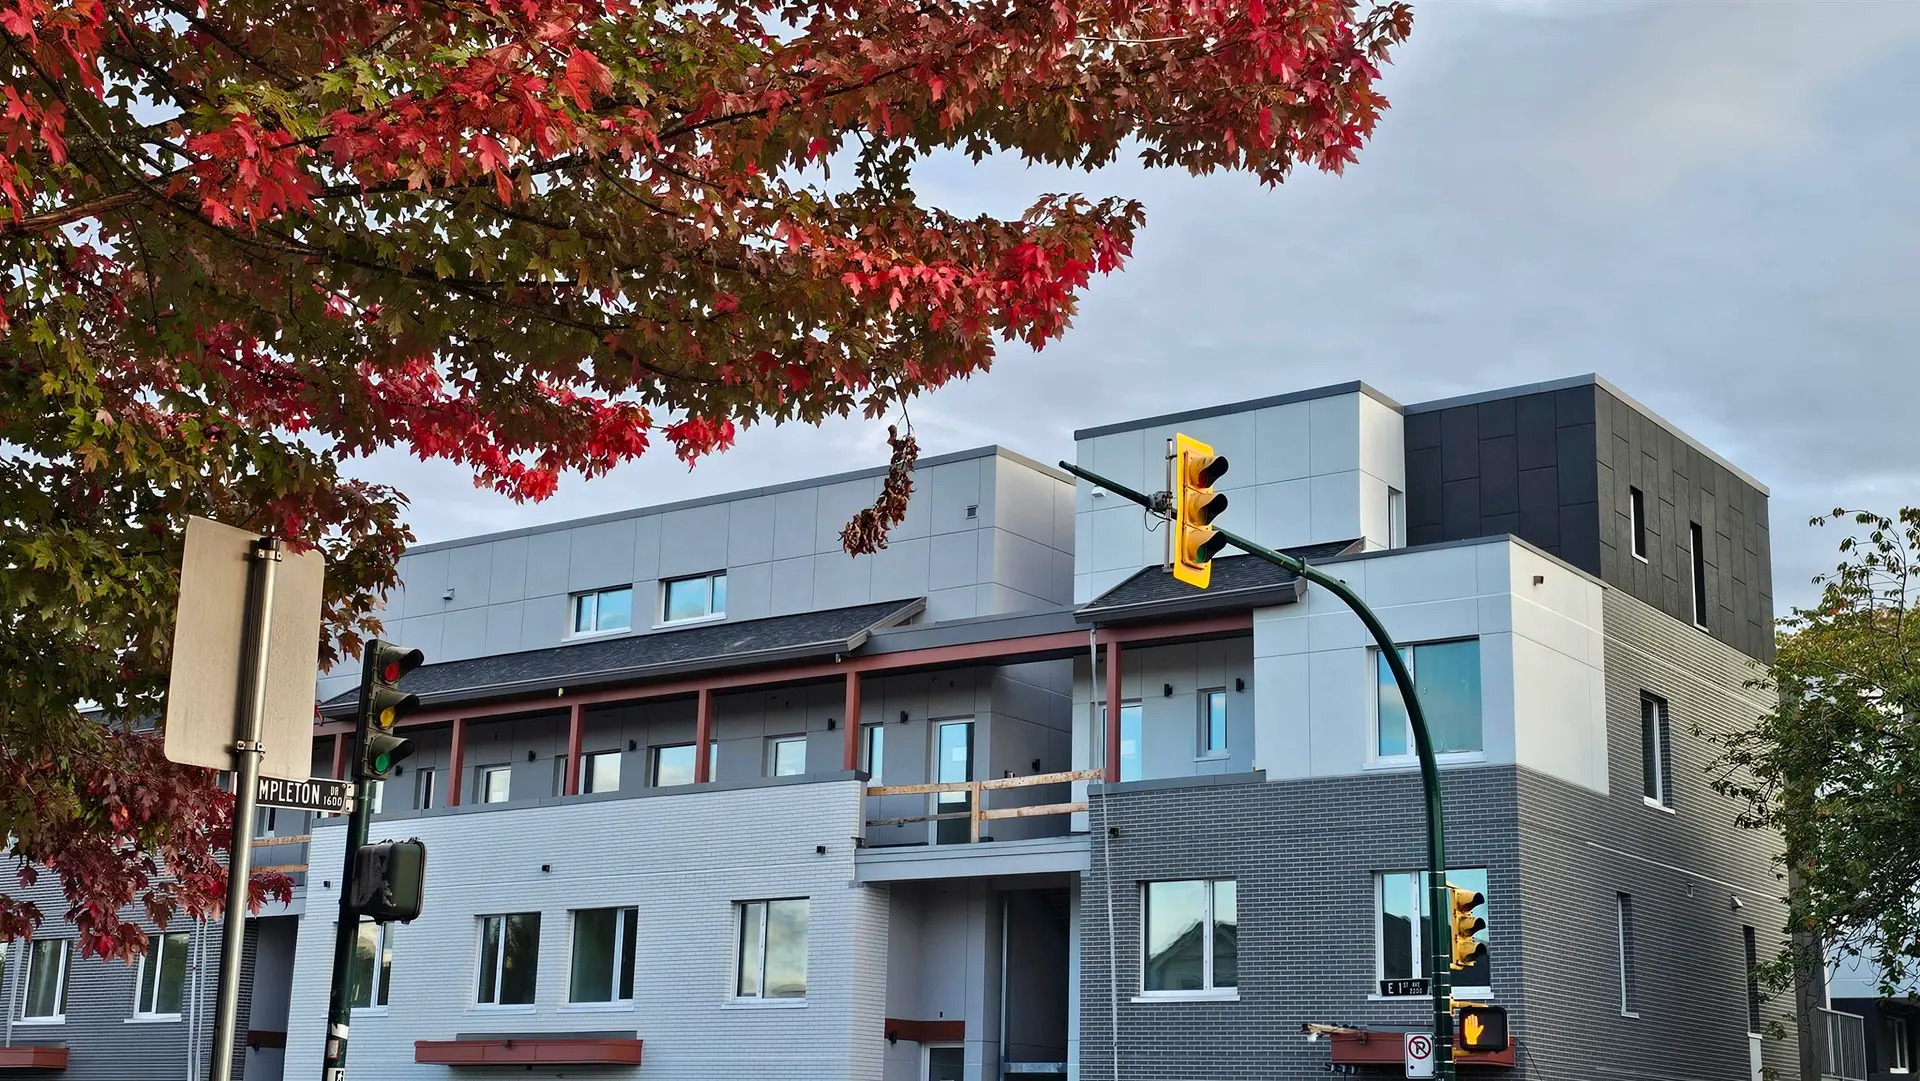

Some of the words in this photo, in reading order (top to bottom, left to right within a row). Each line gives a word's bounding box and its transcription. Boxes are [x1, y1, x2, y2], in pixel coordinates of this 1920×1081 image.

[259, 780, 320, 804] MPLETON
[330, 785, 339, 796] DR
[323, 796, 342, 806] 1600
[1388, 982, 1394, 994] E
